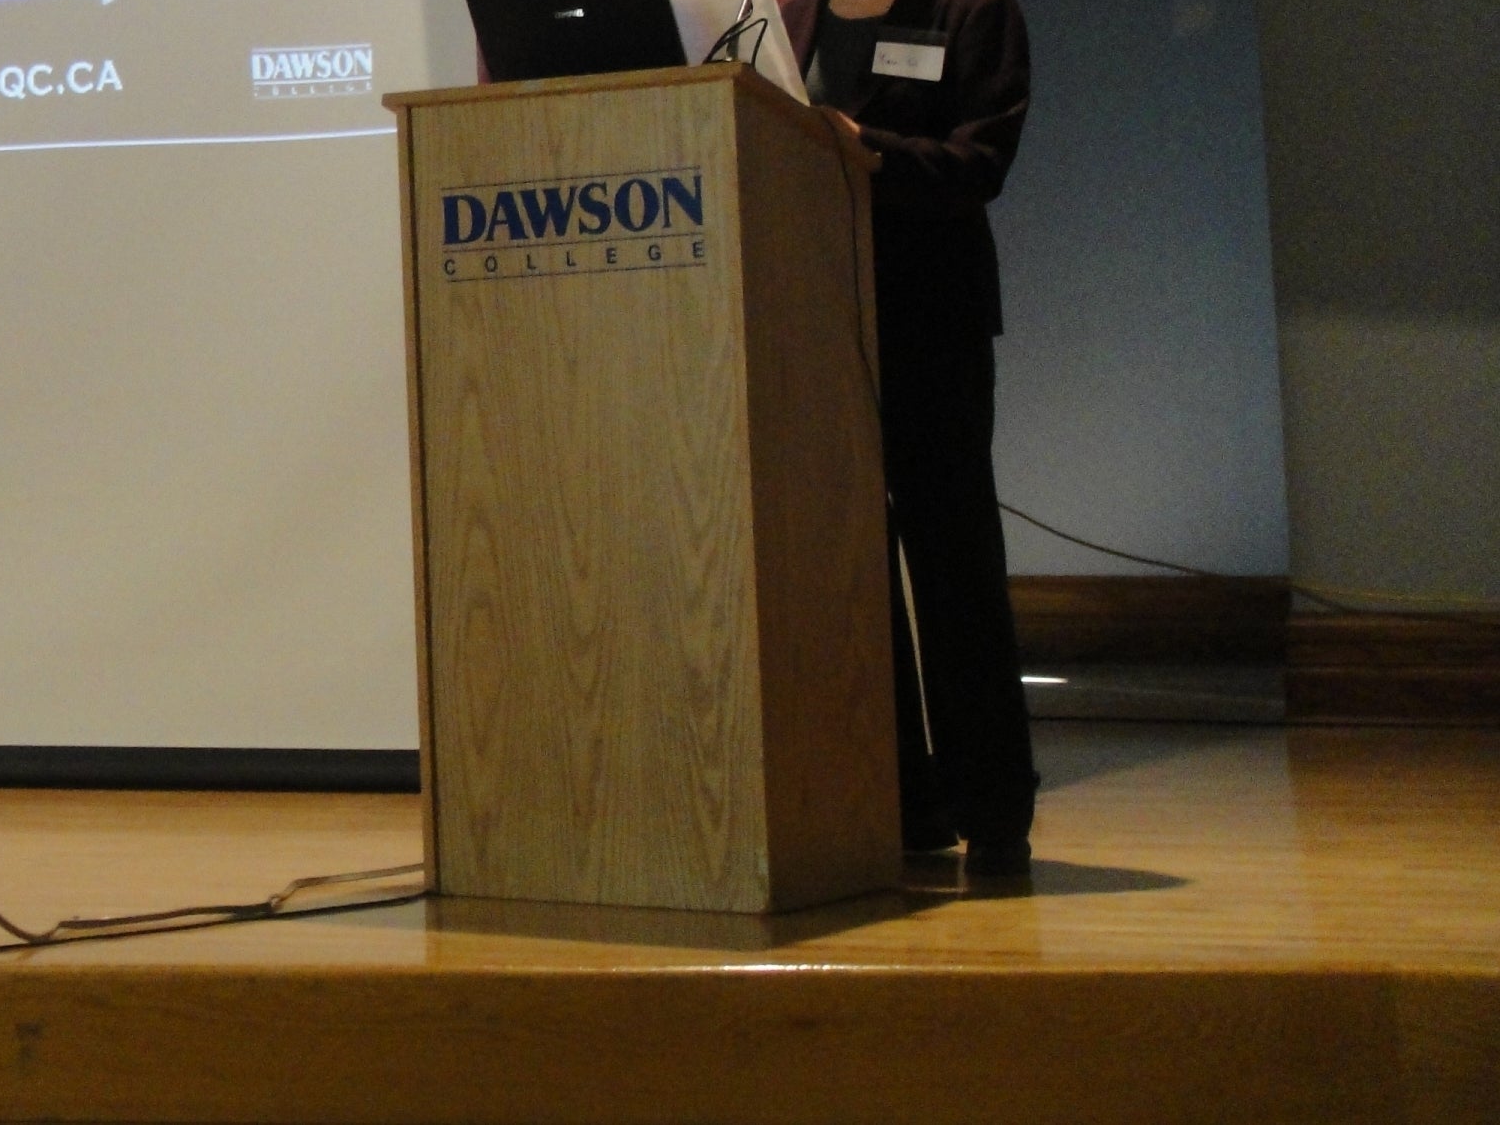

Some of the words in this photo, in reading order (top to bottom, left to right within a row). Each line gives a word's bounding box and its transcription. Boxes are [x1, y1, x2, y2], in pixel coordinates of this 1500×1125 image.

[251, 48, 373, 80] DAWSON
[442, 175, 704, 246] DAWSON
[444, 239, 705, 275] COLLEGE
